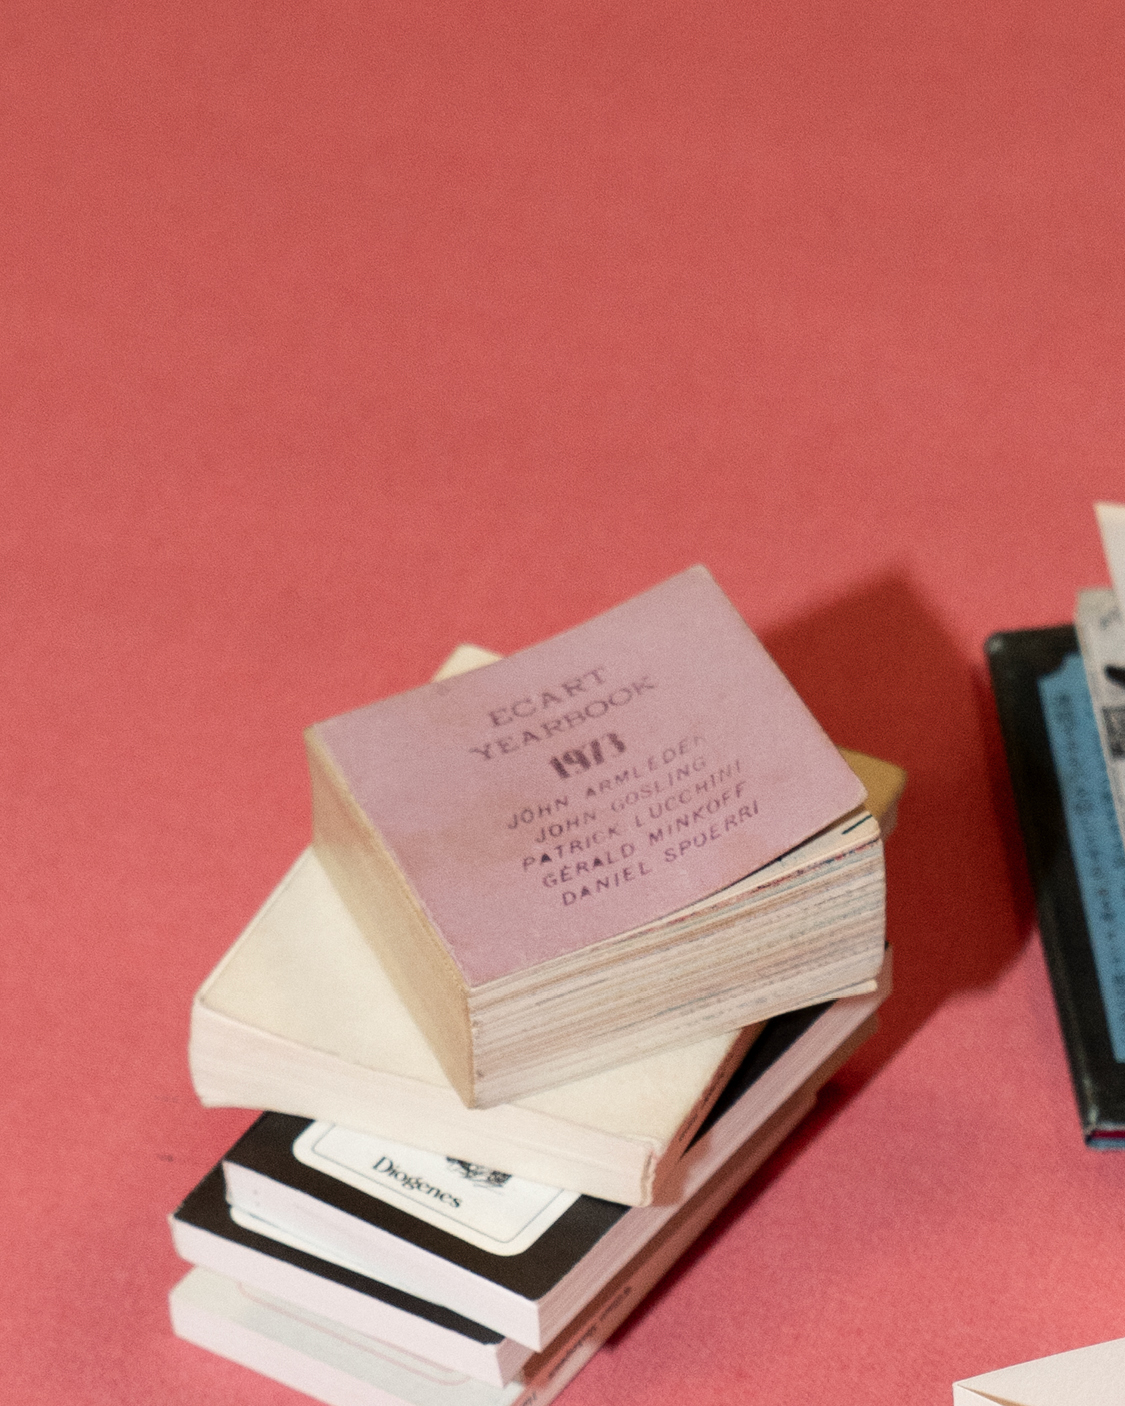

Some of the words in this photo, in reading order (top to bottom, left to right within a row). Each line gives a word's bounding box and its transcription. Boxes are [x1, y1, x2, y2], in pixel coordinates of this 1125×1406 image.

[469, 675, 657, 761] YEARBOOK
[488, 667, 605, 728] ECART
[550, 732, 627, 780] 1973
[507, 795, 569, 830] JOHN
[522, 826, 621, 872] PATRICK
[635, 758, 742, 829] LUCCHINI
[535, 811, 597, 844] JOHN
[610, 756, 707, 813] GOSLING
[649, 781, 748, 847] MINKOFF
[562, 861, 652, 907] DANIEL
[664, 801, 760, 864] SPOERRI
[373, 1156, 462, 1208] Diogenes
